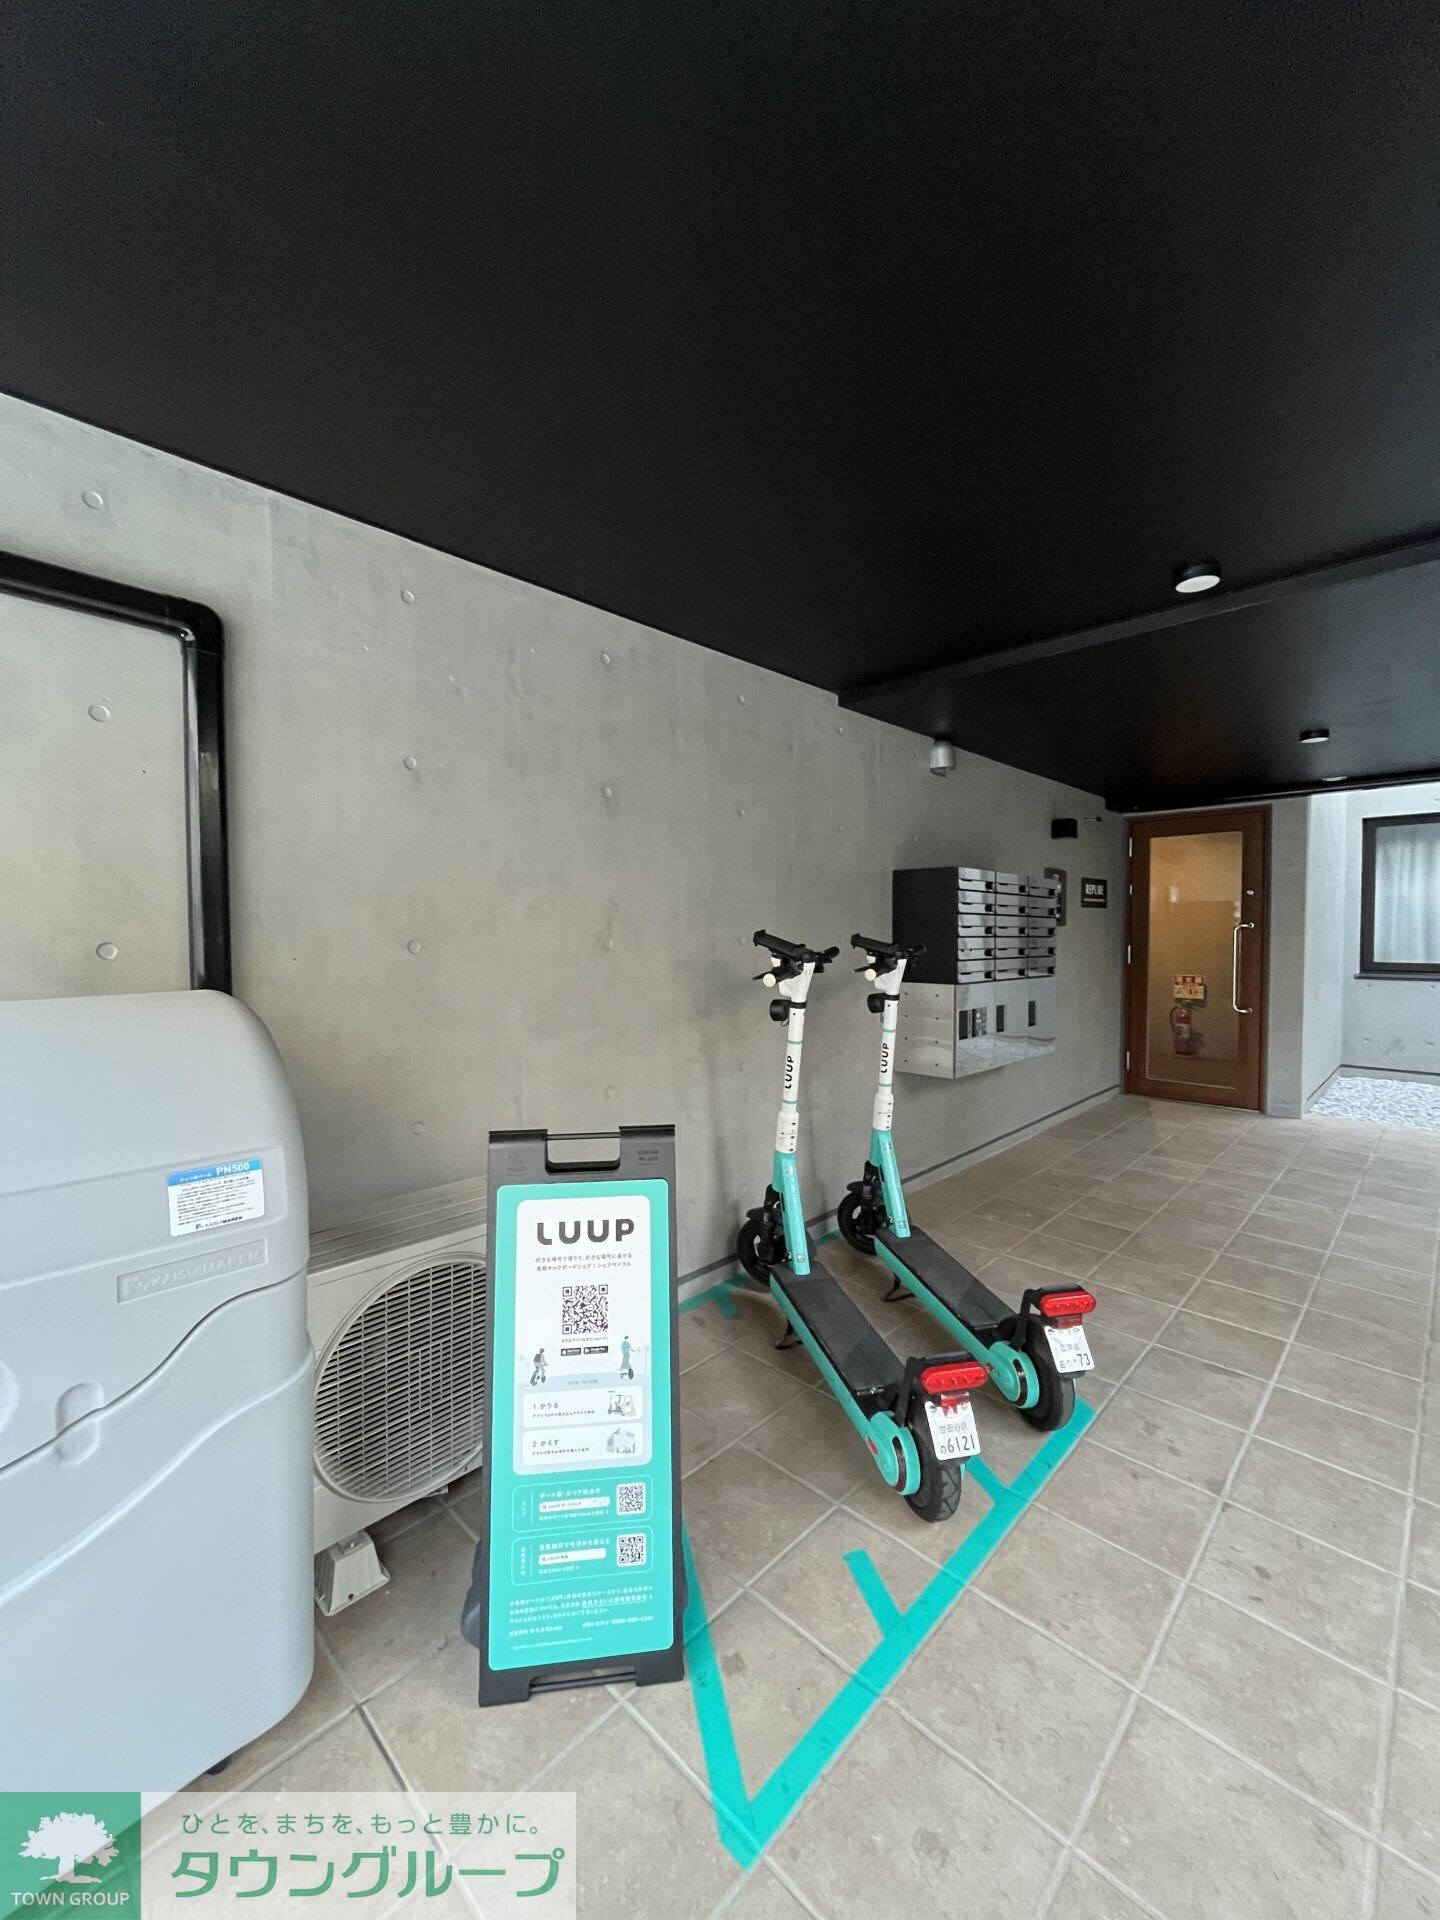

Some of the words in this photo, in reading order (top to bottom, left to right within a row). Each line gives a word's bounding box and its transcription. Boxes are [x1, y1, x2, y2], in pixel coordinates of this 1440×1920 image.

[880, 1042, 890, 1074] LUUP
[784, 1055, 794, 1090] LUUP
[215, 1162, 250, 1176] PN500
[536, 1218, 635, 1246] LUUP
[540, 1402, 559, 1410] かりる
